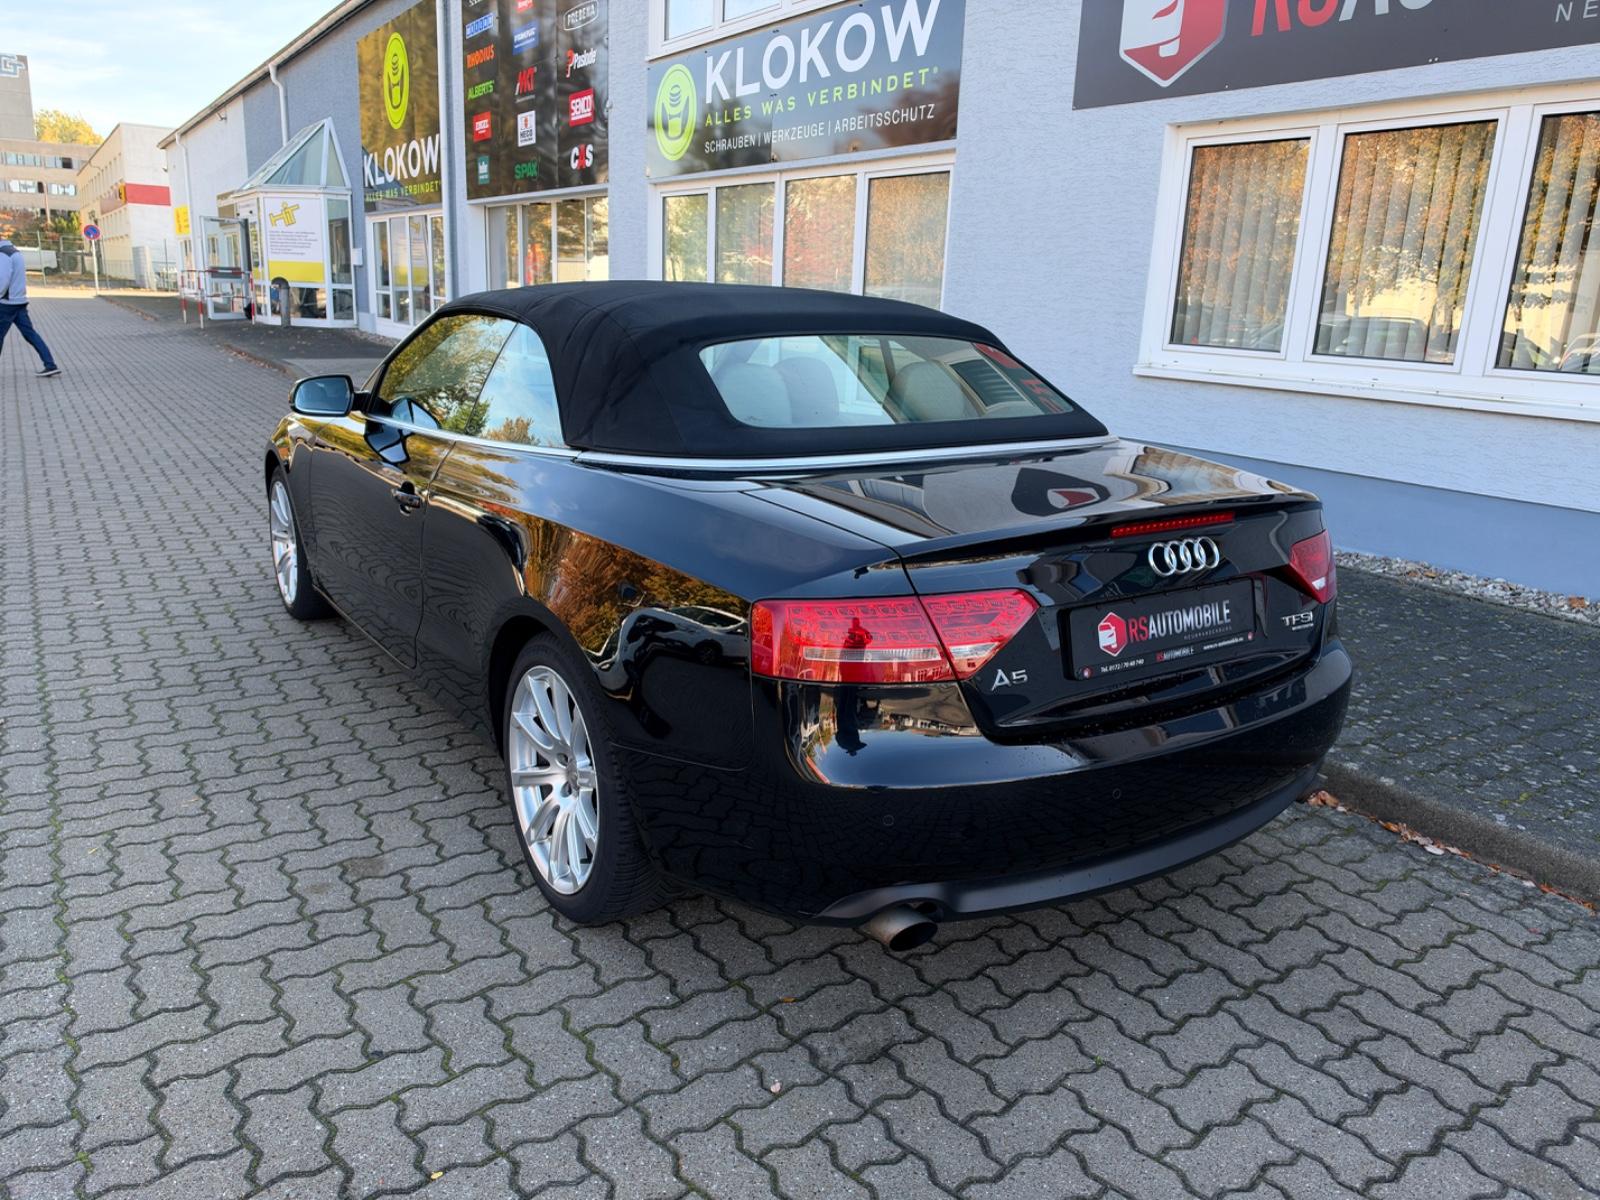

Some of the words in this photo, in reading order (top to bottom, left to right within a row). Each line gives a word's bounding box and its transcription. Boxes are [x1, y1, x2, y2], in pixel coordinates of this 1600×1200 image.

[705, 0, 940, 104] KLOKOW
[704, 134, 756, 154] SCHRAUBEN
[763, 122, 825, 145] WERKZEUGE
[834, 103, 935, 134] ARBEITSSCHUTZ
[705, 105, 752, 127] ALLES
[761, 96, 796, 116] WAS
[363, 133, 440, 188] KLOKOW
[1128, 600, 1231, 643] RSAUTOMOBILE
[1281, 611, 1313, 626] TFSI
[991, 669, 1028, 691] A5
